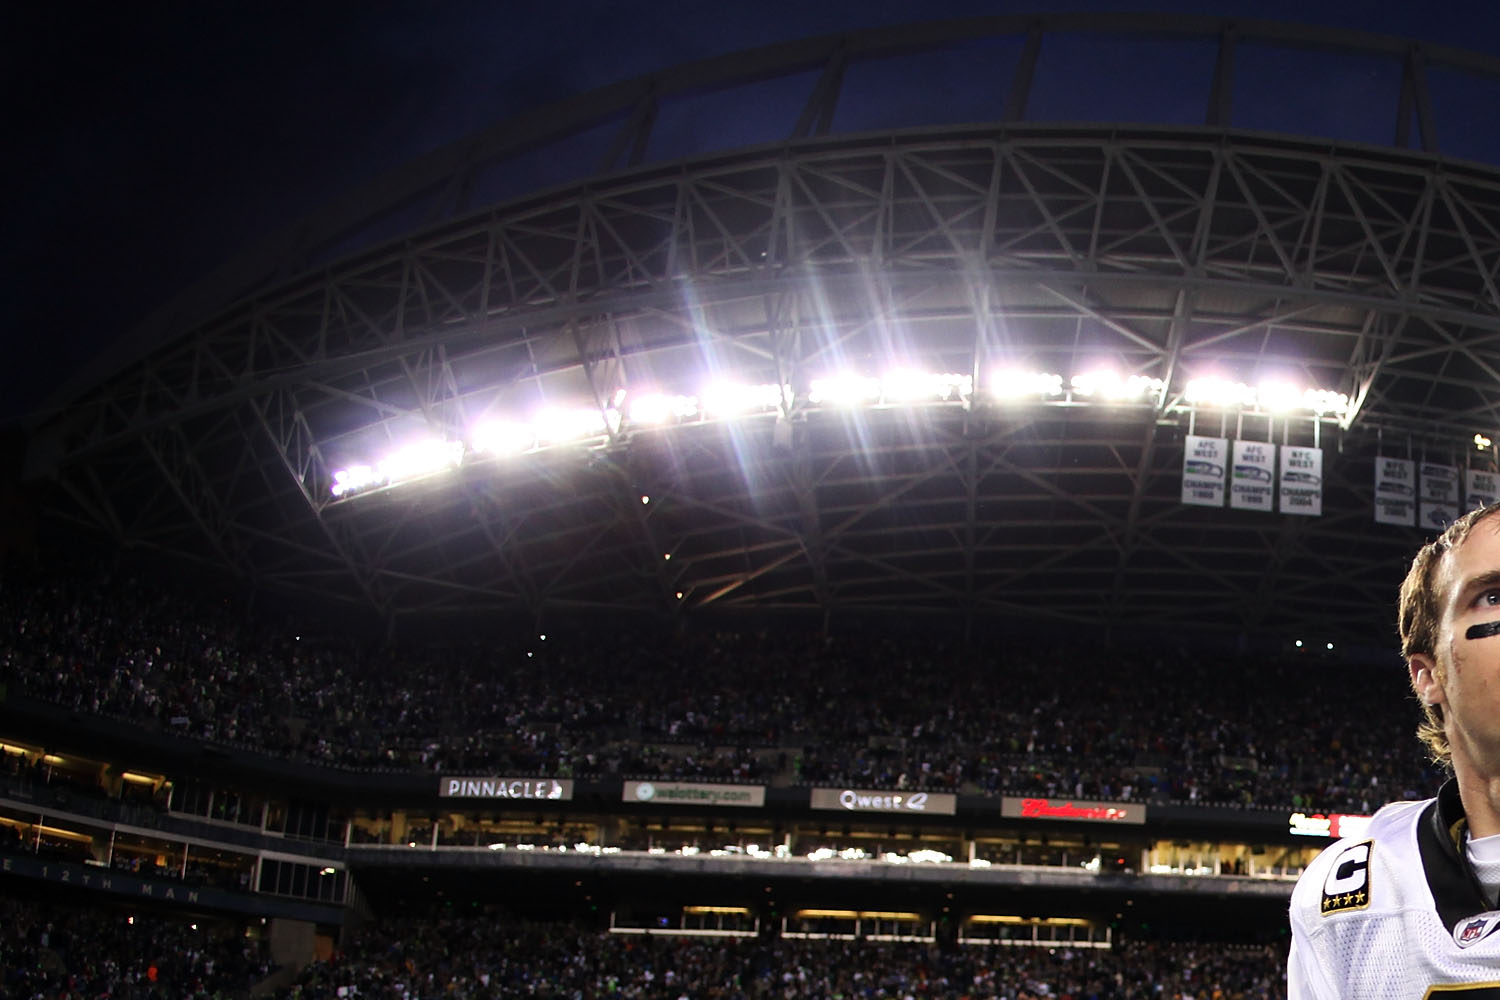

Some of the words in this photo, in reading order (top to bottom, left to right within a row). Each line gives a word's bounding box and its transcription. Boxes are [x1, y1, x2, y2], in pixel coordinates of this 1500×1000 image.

[449, 780, 547, 799] PINNACLE
[840, 790, 903, 810] Qwest
[1325, 845, 1370, 896] C
[142, 883, 199, 903] MAN
